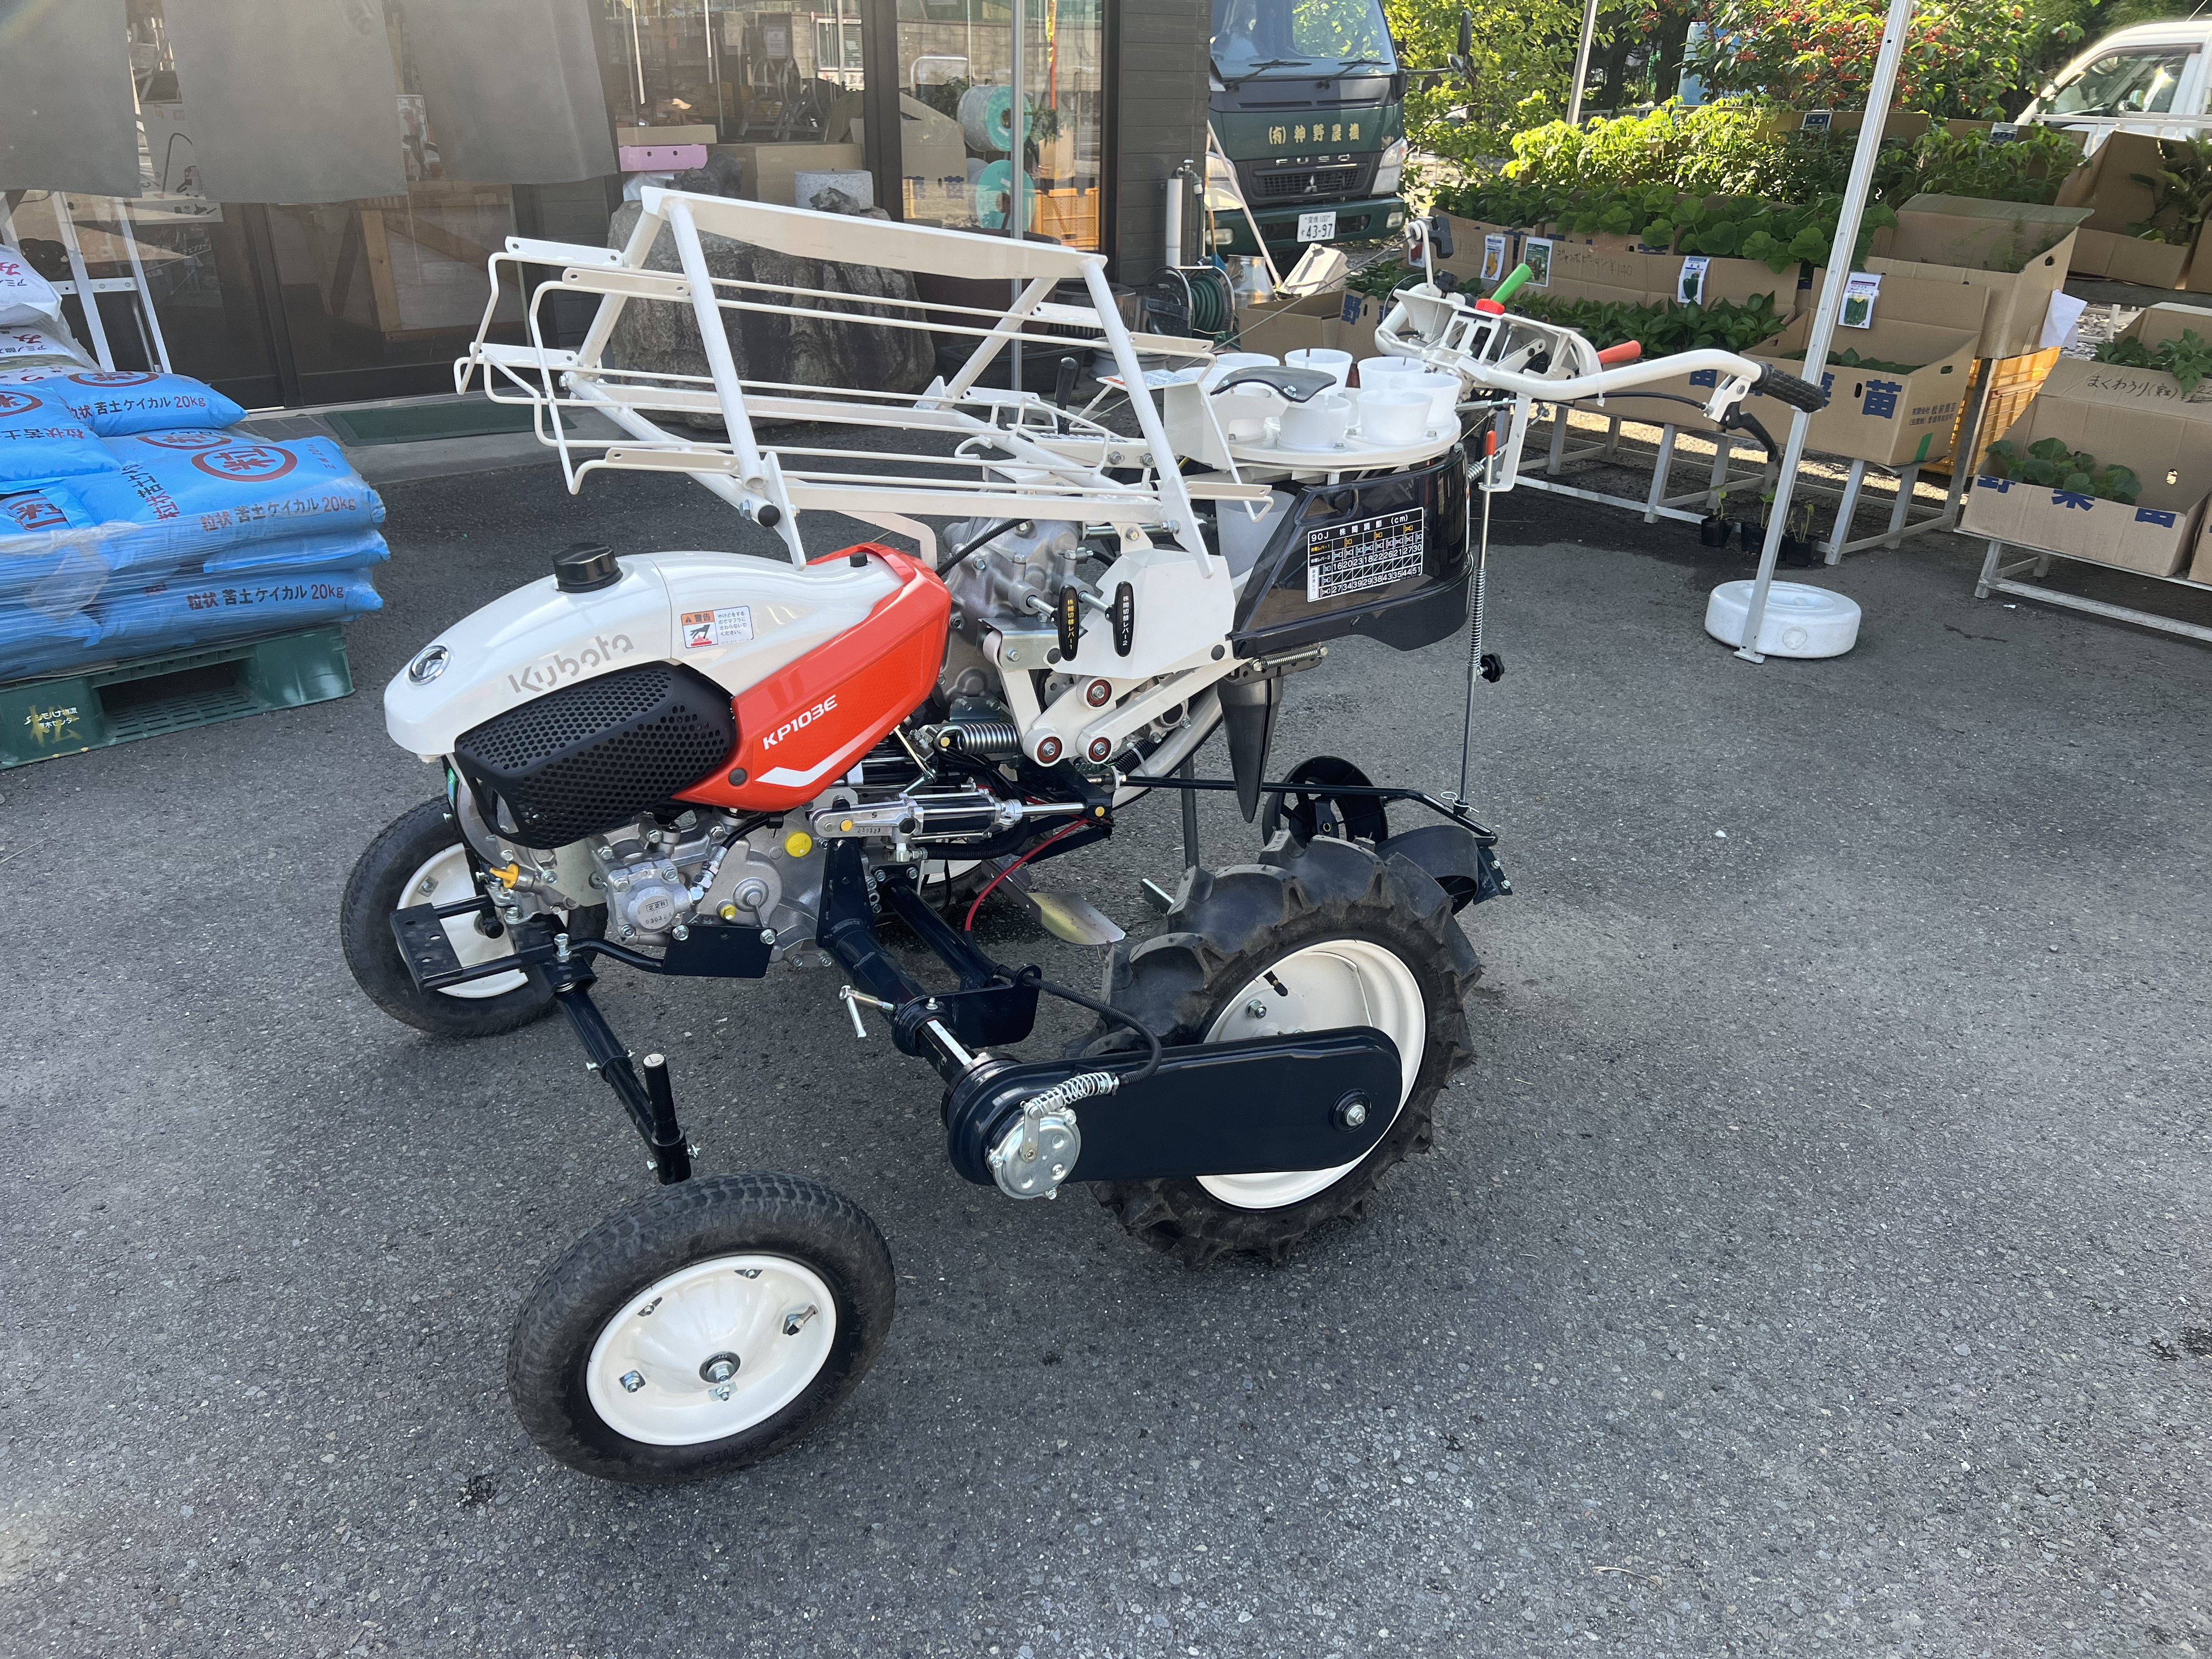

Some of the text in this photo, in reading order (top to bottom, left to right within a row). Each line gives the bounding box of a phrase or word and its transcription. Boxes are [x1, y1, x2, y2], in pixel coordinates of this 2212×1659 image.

[1276, 154, 1351, 166] FUSO
[1307, 223, 1333, 239] 43-97
[97, 397, 171, 415] 苦土ケイカル
[173, 396, 206, 408] 20kg
[1862, 379, 1903, 419] 苗
[234, 497, 319, 523] 苦土ケイカル
[321, 496, 357, 512] 20kg
[1311, 531, 1329, 541] 90J
[1391, 515, 1408, 524] (cm)
[1333, 562, 1342, 571] 16
[1343, 560, 1352, 568] 20
[1353, 558, 1363, 566] 23
[1364, 555, 1373, 563] 18
[1374, 553, 1383, 561] 22
[1384, 551, 1393, 559] 26
[1393, 549, 1402, 557] 21
[1413, 544, 1422, 552] 30
[1333, 585, 1341, 593] 27
[1342, 583, 1352, 591] 34
[1353, 580, 1362, 588] 39
[1363, 578, 1372, 586] 29
[1393, 571, 1402, 579] 35
[1412, 566, 1420, 574] 51
[223, 585, 307, 606] 苦土ケイカル
[311, 584, 344, 600] 20kg
[718, 617, 746, 625] のでマフラに
[719, 623, 747, 631] さわらないで
[507, 634, 635, 693] Kubota
[763, 694, 839, 751] KP103E
[645, 912, 672, 924] 030323
